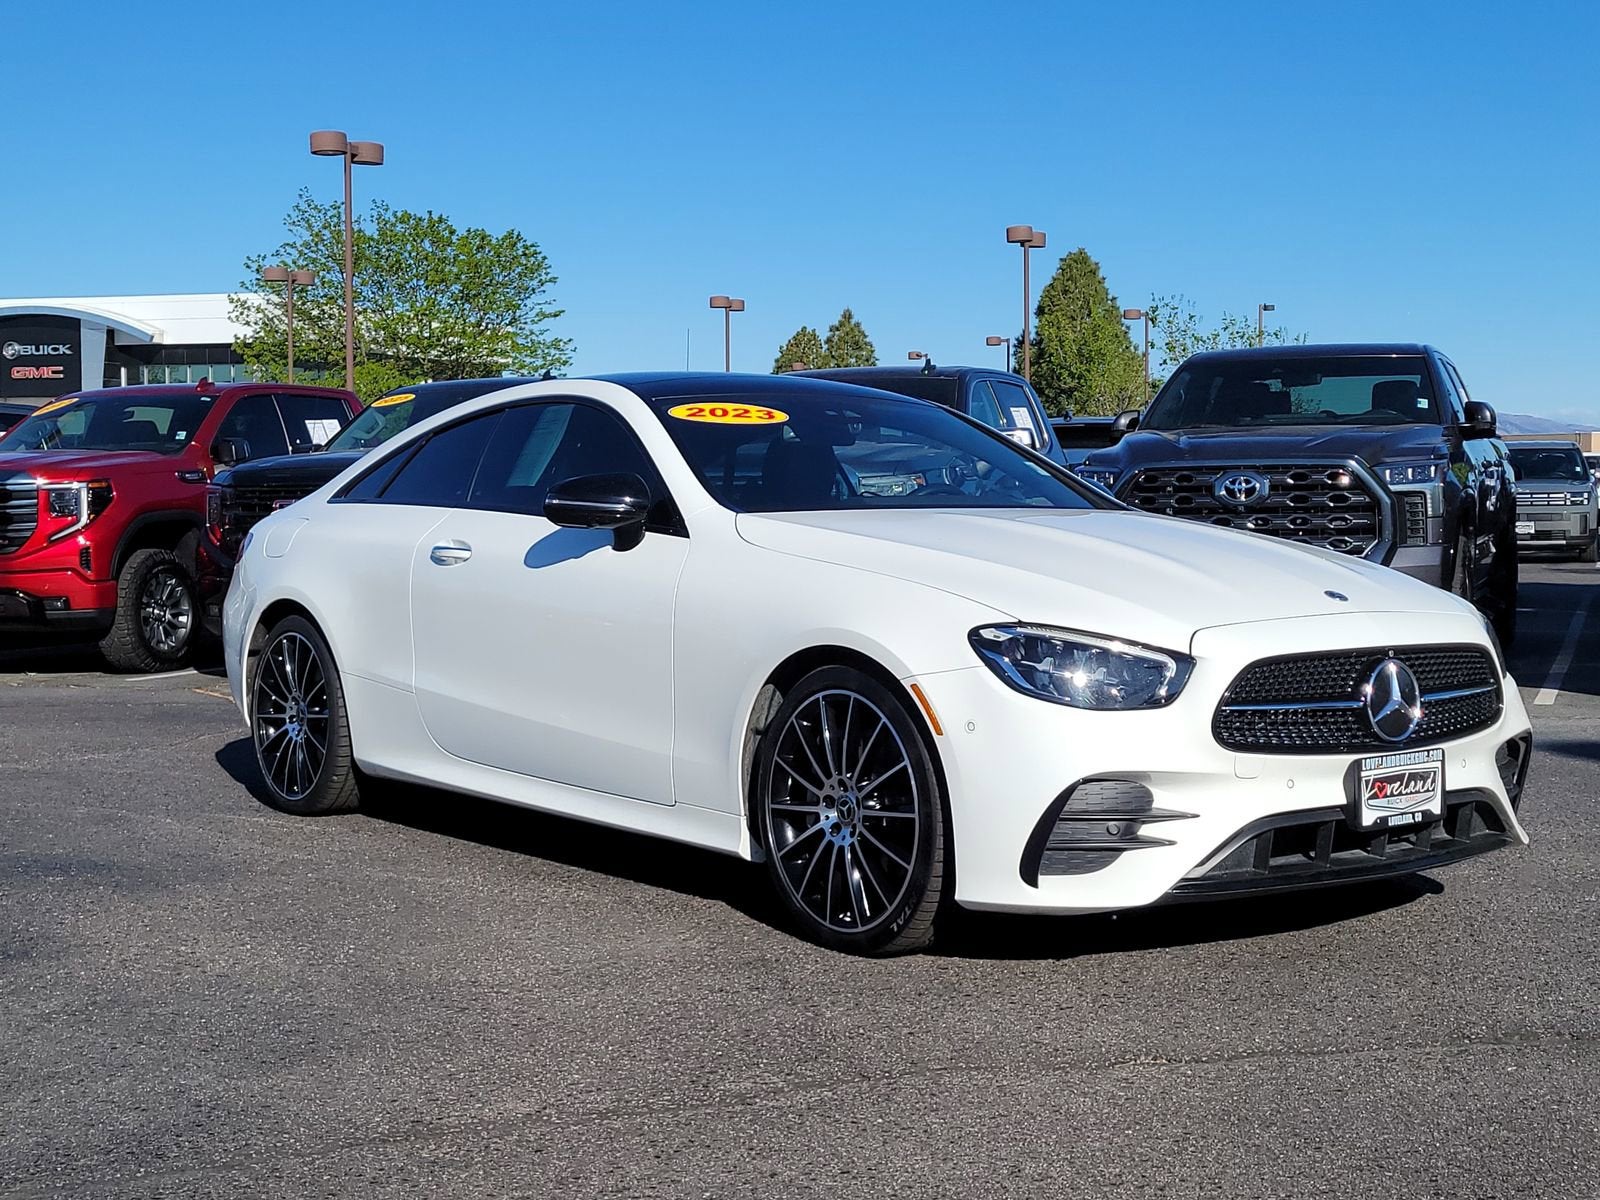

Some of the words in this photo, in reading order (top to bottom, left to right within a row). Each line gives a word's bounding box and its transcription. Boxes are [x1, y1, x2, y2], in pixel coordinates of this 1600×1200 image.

[20, 344, 74, 355] BUICK
[10, 366, 64, 379] GMC
[685, 407, 776, 420] 2023
